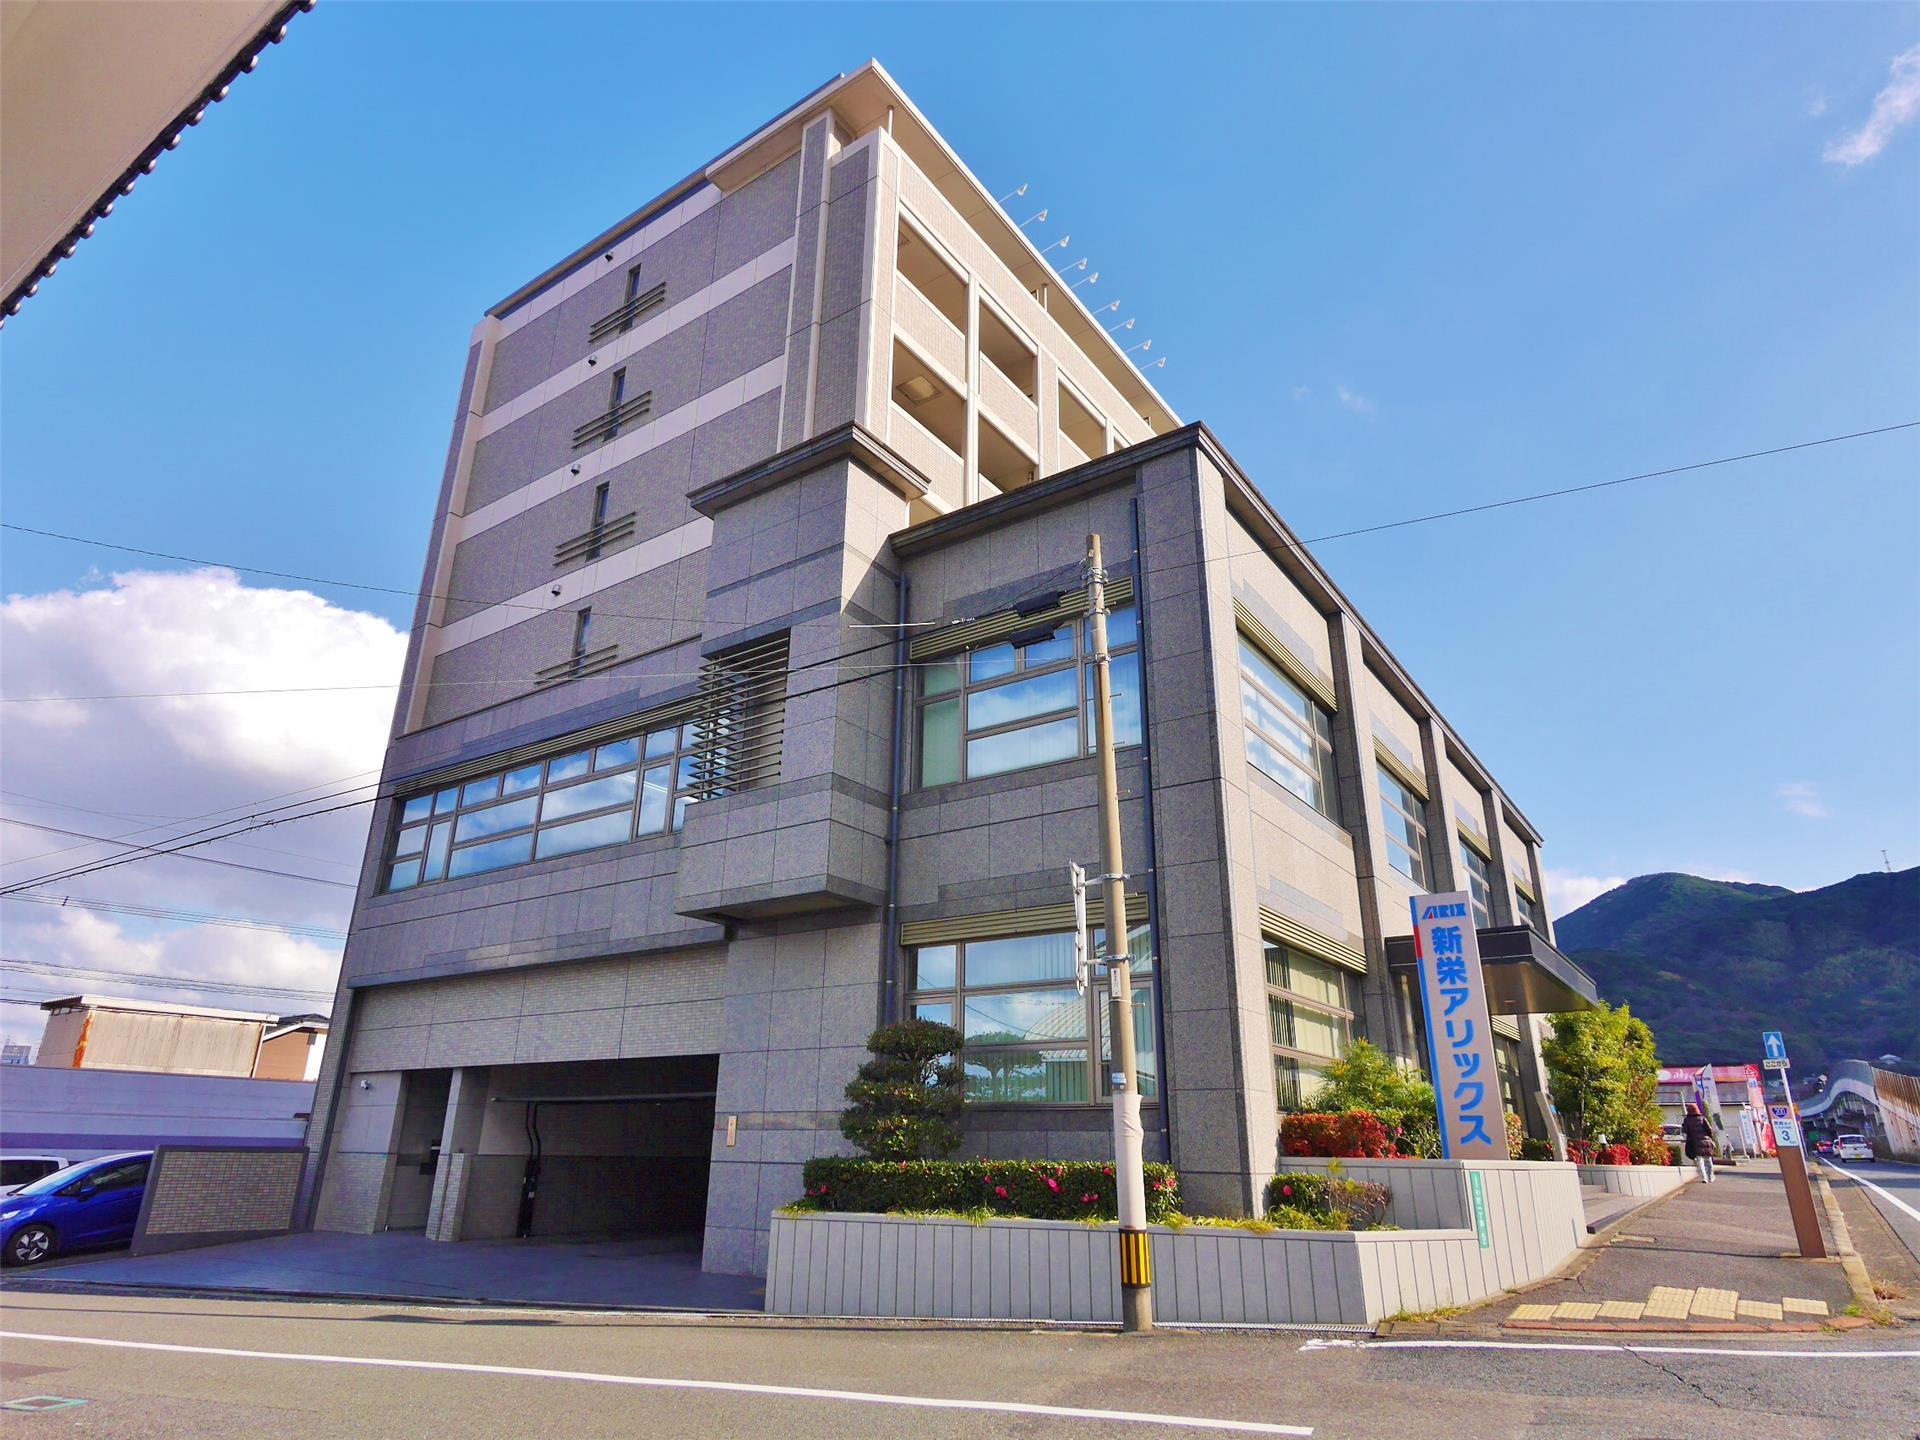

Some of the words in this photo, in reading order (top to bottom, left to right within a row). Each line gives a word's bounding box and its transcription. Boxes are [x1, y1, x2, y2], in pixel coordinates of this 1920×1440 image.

[1431, 925, 1492, 1146] 新栄アリックス
[1765, 1059, 1788, 1068] ここから
[1775, 1108, 1786, 1116] 200
[1781, 1130, 1790, 1141] 3
